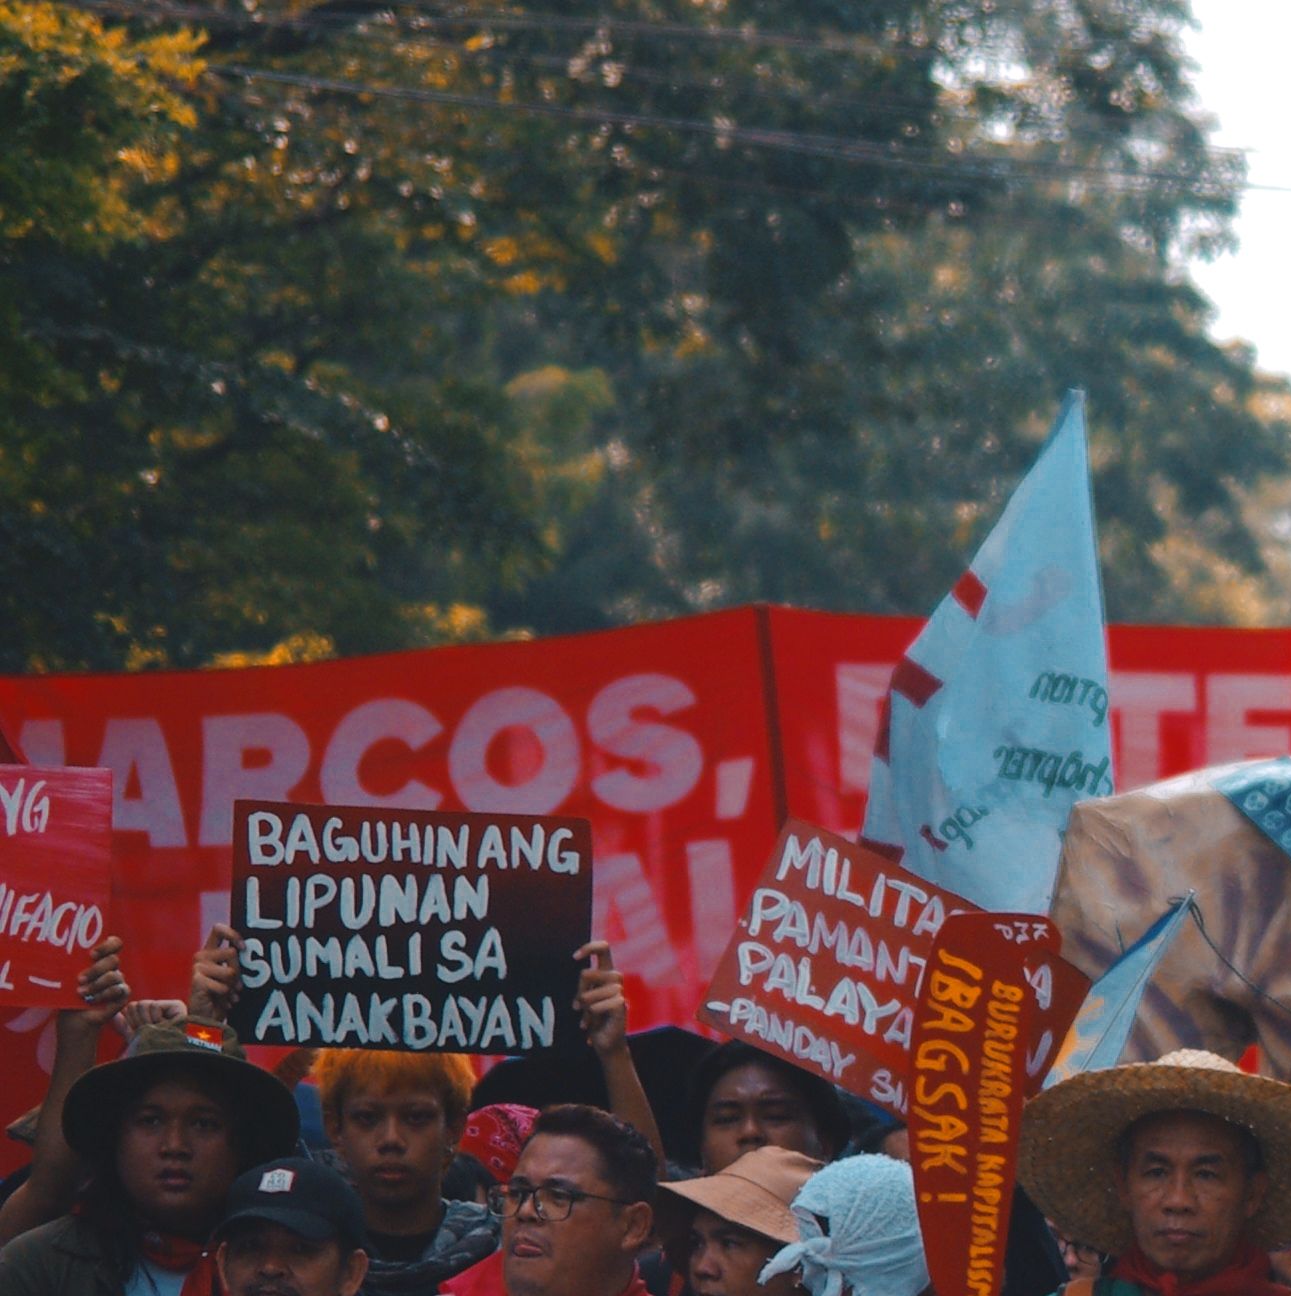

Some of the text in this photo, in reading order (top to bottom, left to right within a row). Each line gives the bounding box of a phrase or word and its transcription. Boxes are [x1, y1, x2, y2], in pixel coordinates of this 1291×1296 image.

[19, 673, 754, 847] ARCOS,
[247, 811, 580, 875] BAGUHIN ANG
[0, 882, 103, 955] IFACIO
[246, 873, 490, 930] LIPUNAN
[775, 834, 968, 937] MILITA
[241, 927, 508, 989] SUMALI SA
[975, 979, 1025, 1143] BURUKRATA
